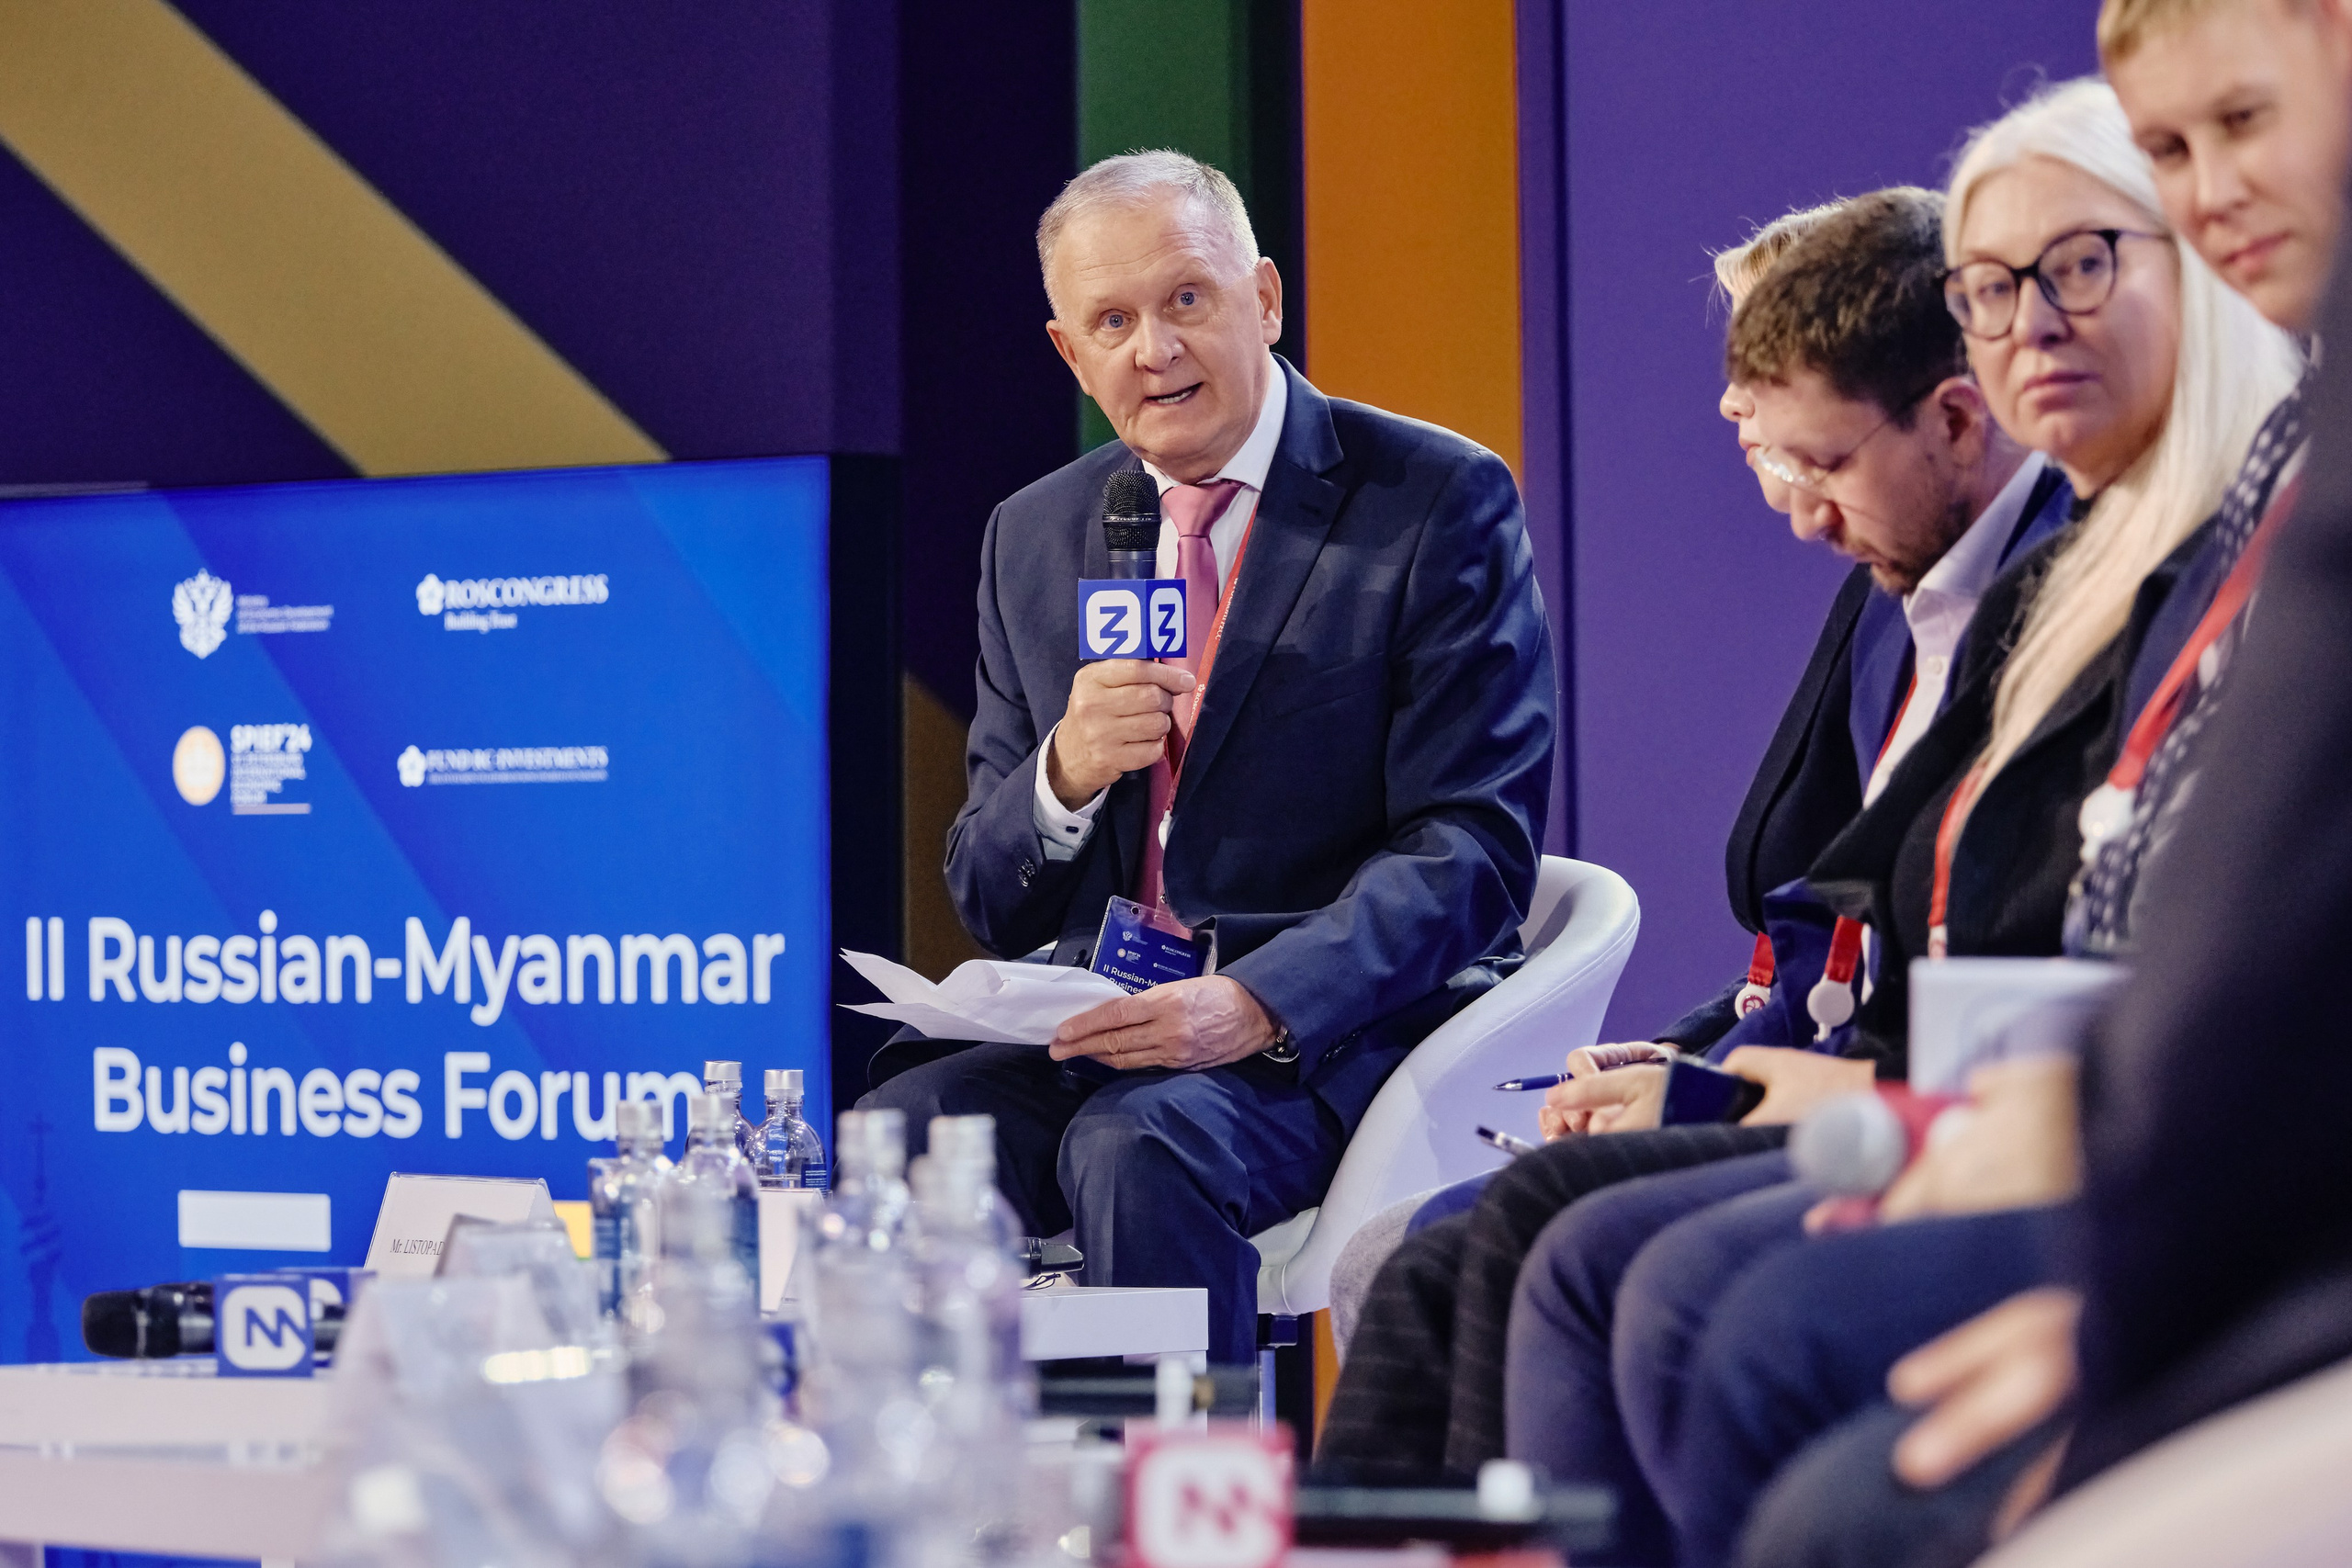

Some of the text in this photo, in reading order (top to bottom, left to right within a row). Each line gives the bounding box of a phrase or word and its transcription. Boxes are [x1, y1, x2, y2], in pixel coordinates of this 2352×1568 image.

[26, 909, 786, 1026] II Russian-Myanmar
[93, 1042, 706, 1142] Business Forum
[390, 1239, 402, 1254] Mr.
